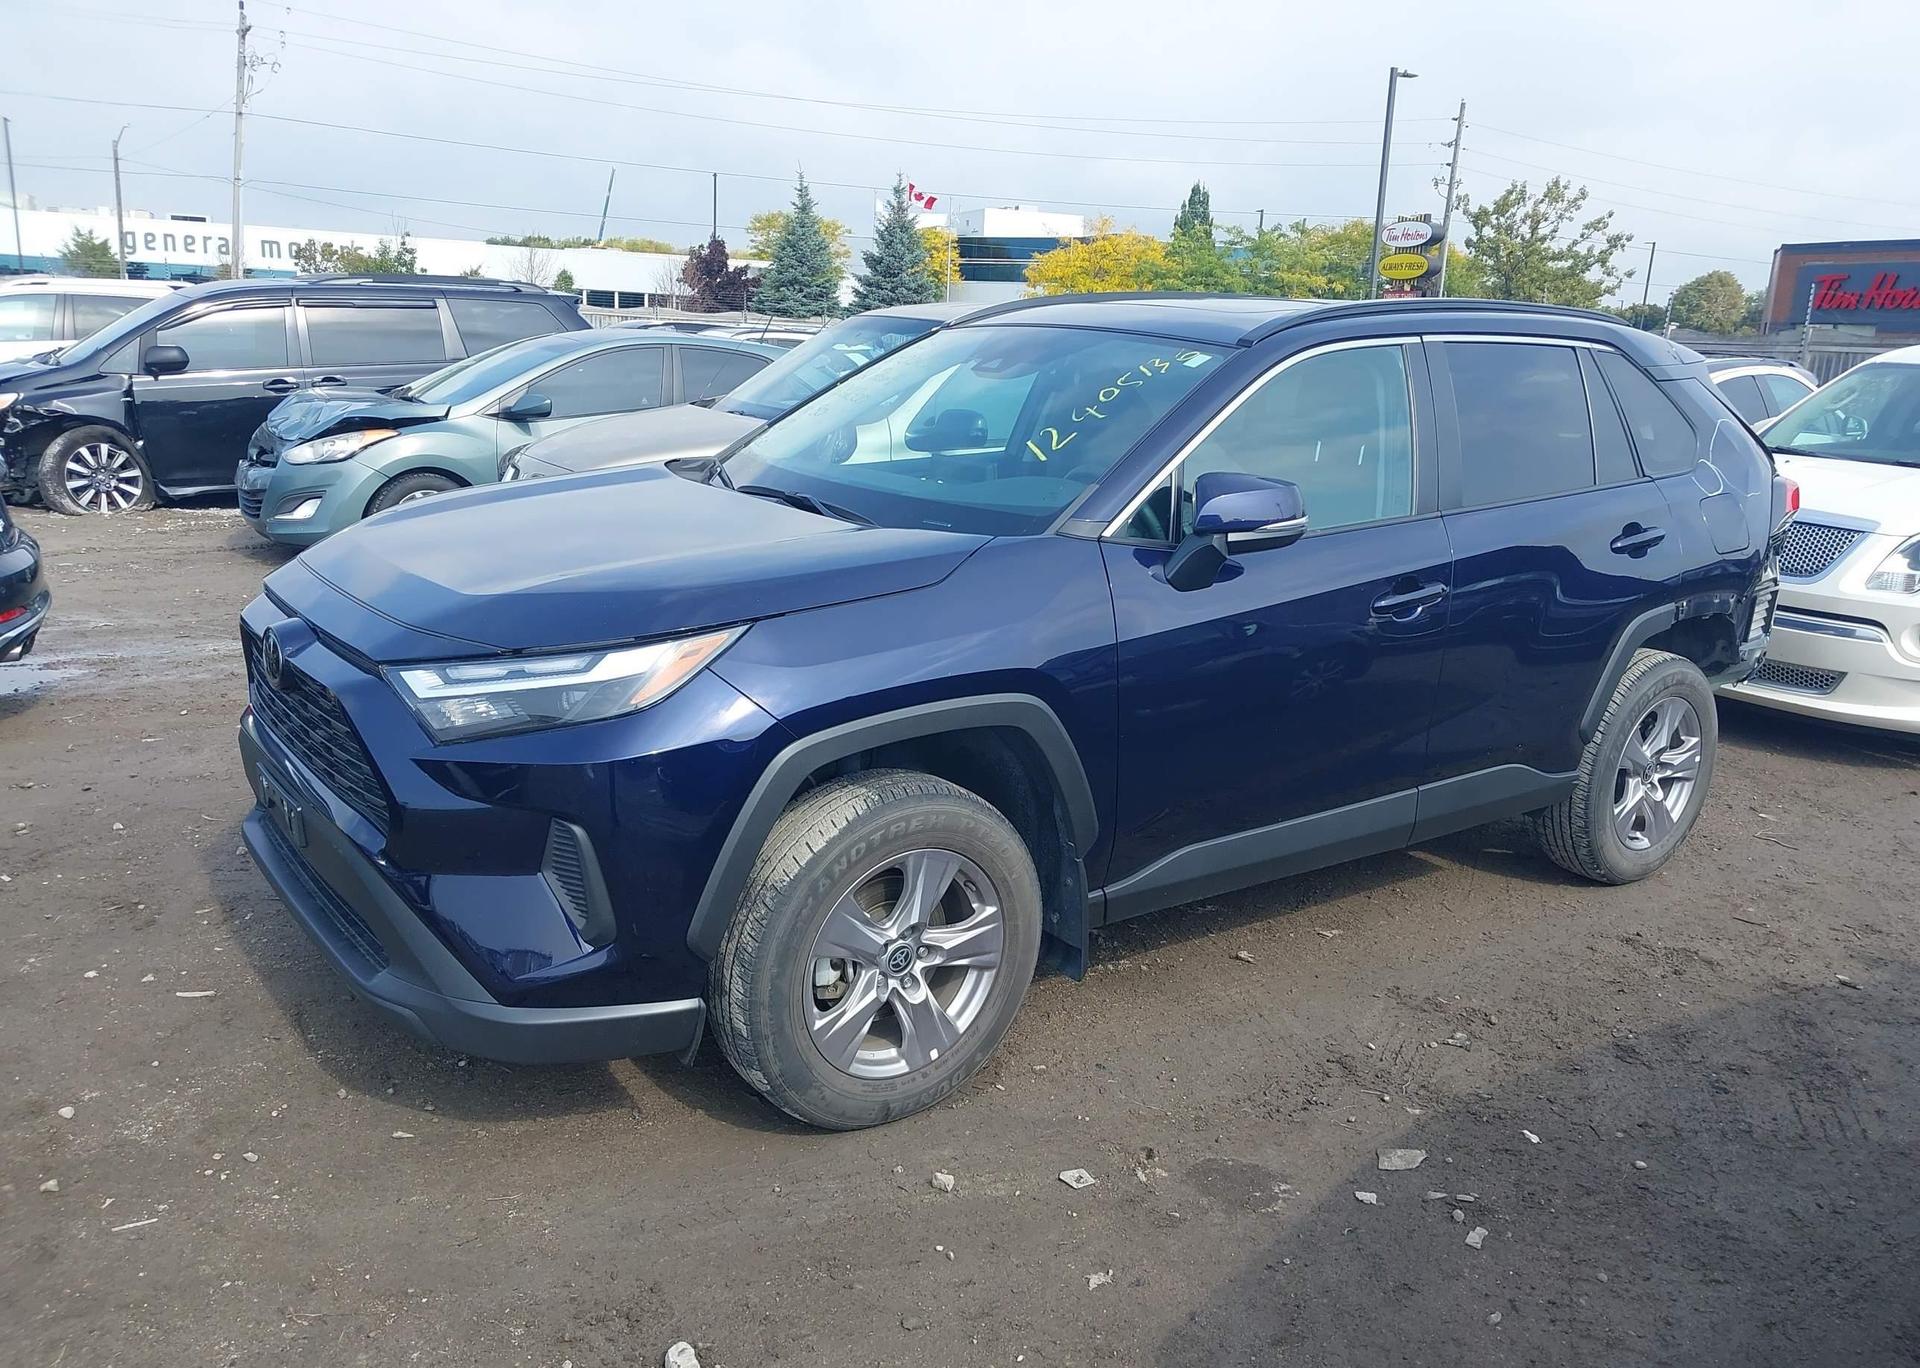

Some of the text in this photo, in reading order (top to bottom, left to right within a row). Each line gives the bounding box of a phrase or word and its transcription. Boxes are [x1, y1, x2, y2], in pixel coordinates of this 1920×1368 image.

[123, 230, 231, 256] genera
[1385, 226, 1428, 242] Tim Hortons
[1382, 261, 1425, 271] ALWAYS FRESH
[1813, 271, 1920, 311] Tim Hor
